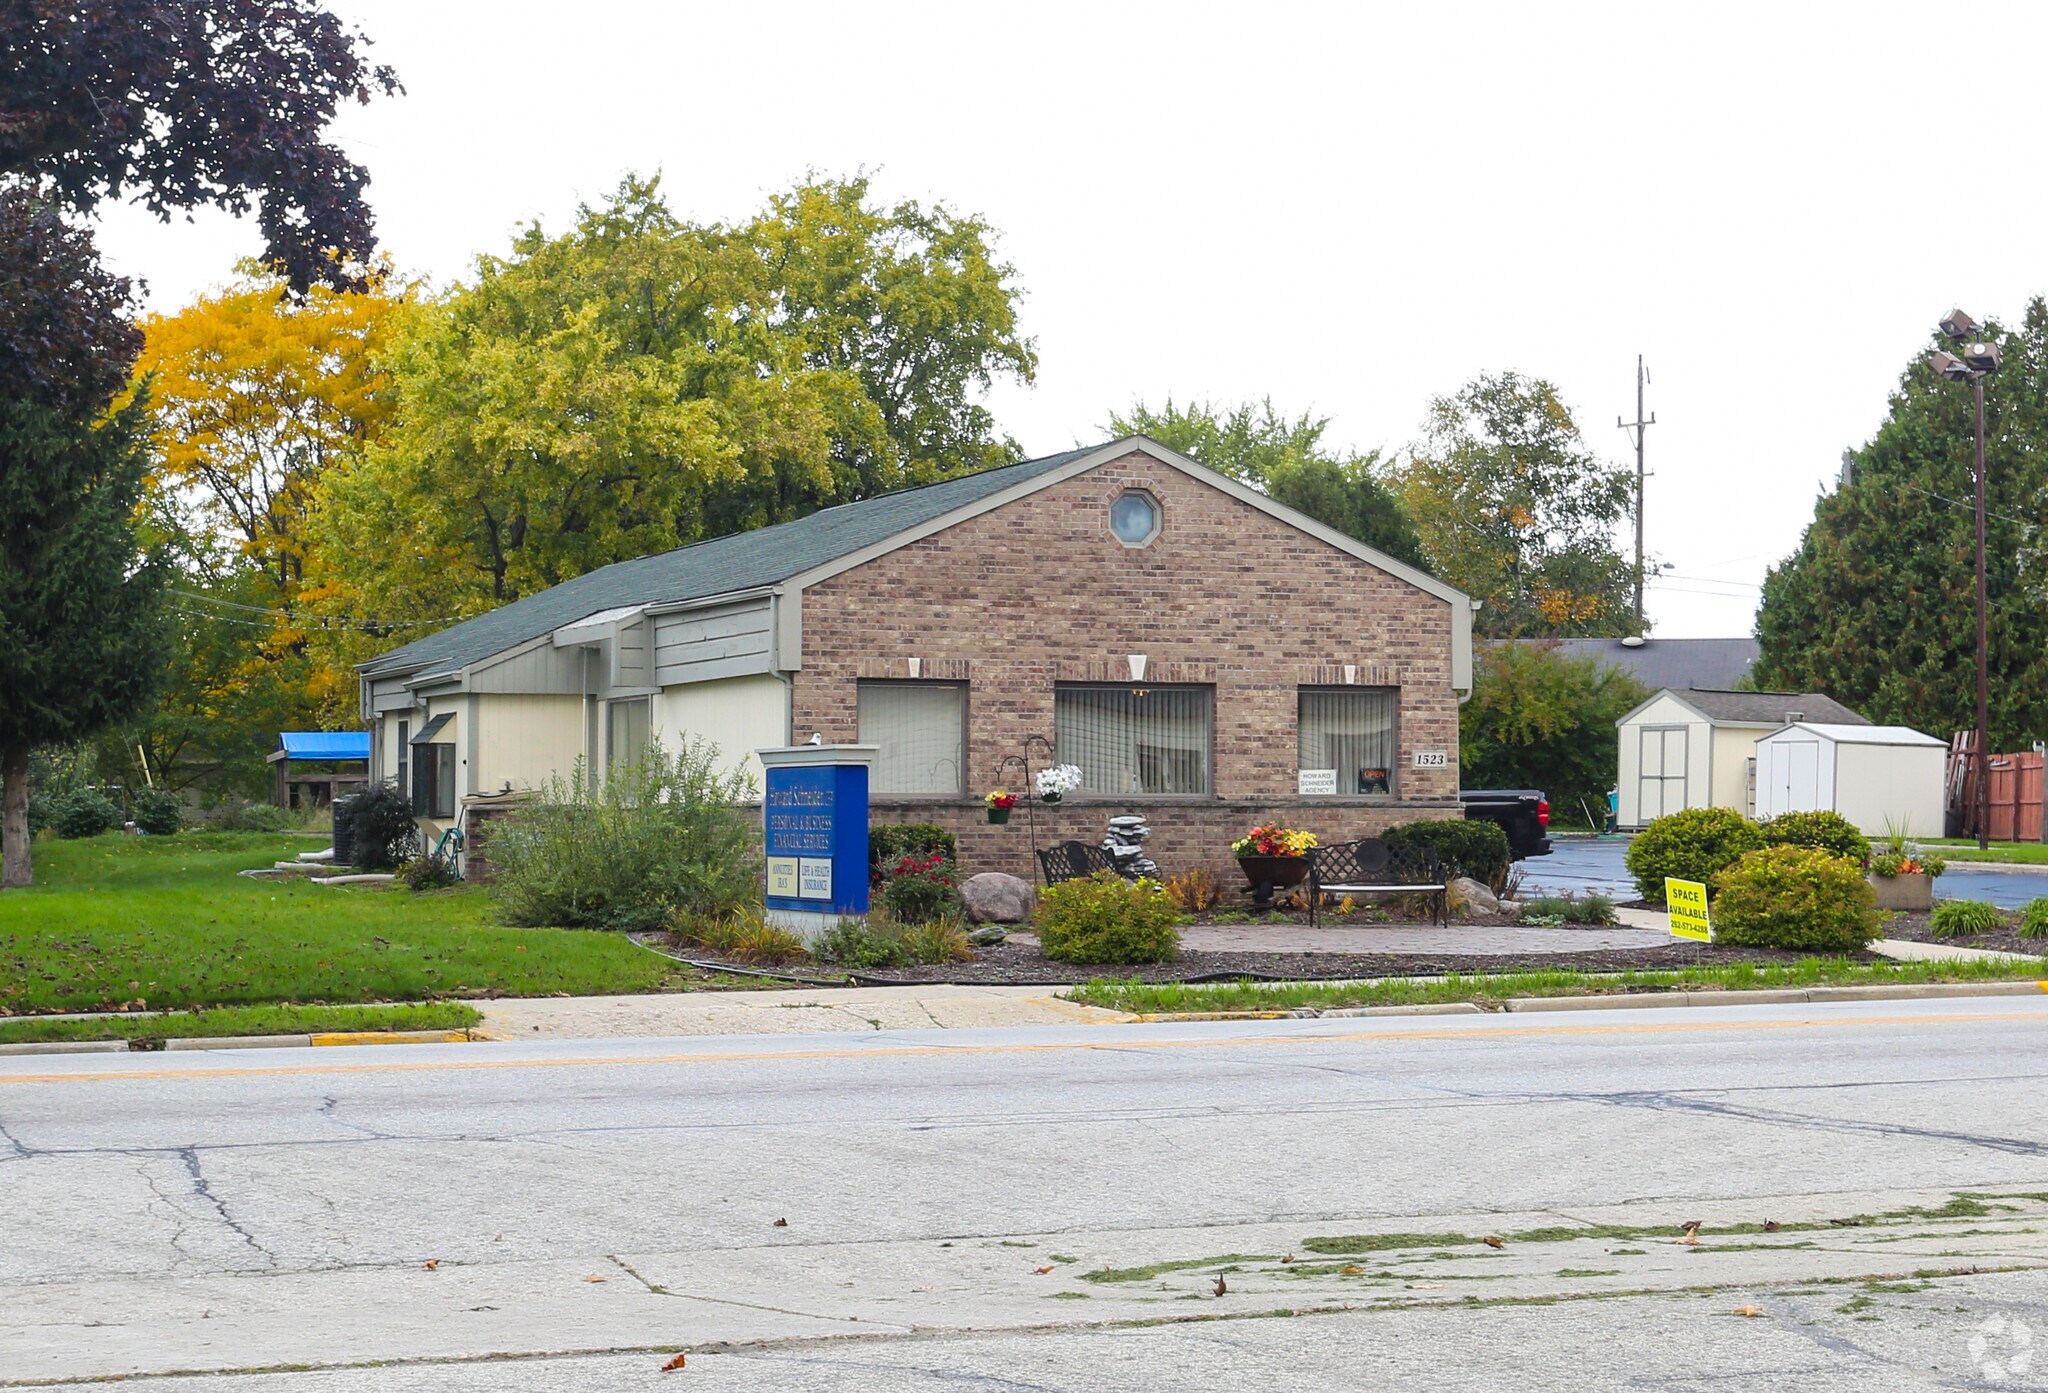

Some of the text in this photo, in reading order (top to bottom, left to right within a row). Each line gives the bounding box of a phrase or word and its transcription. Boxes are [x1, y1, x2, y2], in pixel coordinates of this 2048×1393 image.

[1417, 754, 1444, 765] 1523
[1364, 770, 1385, 778] OPEN
[1672, 888, 1699, 902] SPACE
[1669, 904, 1707, 920] AVAILABLE
